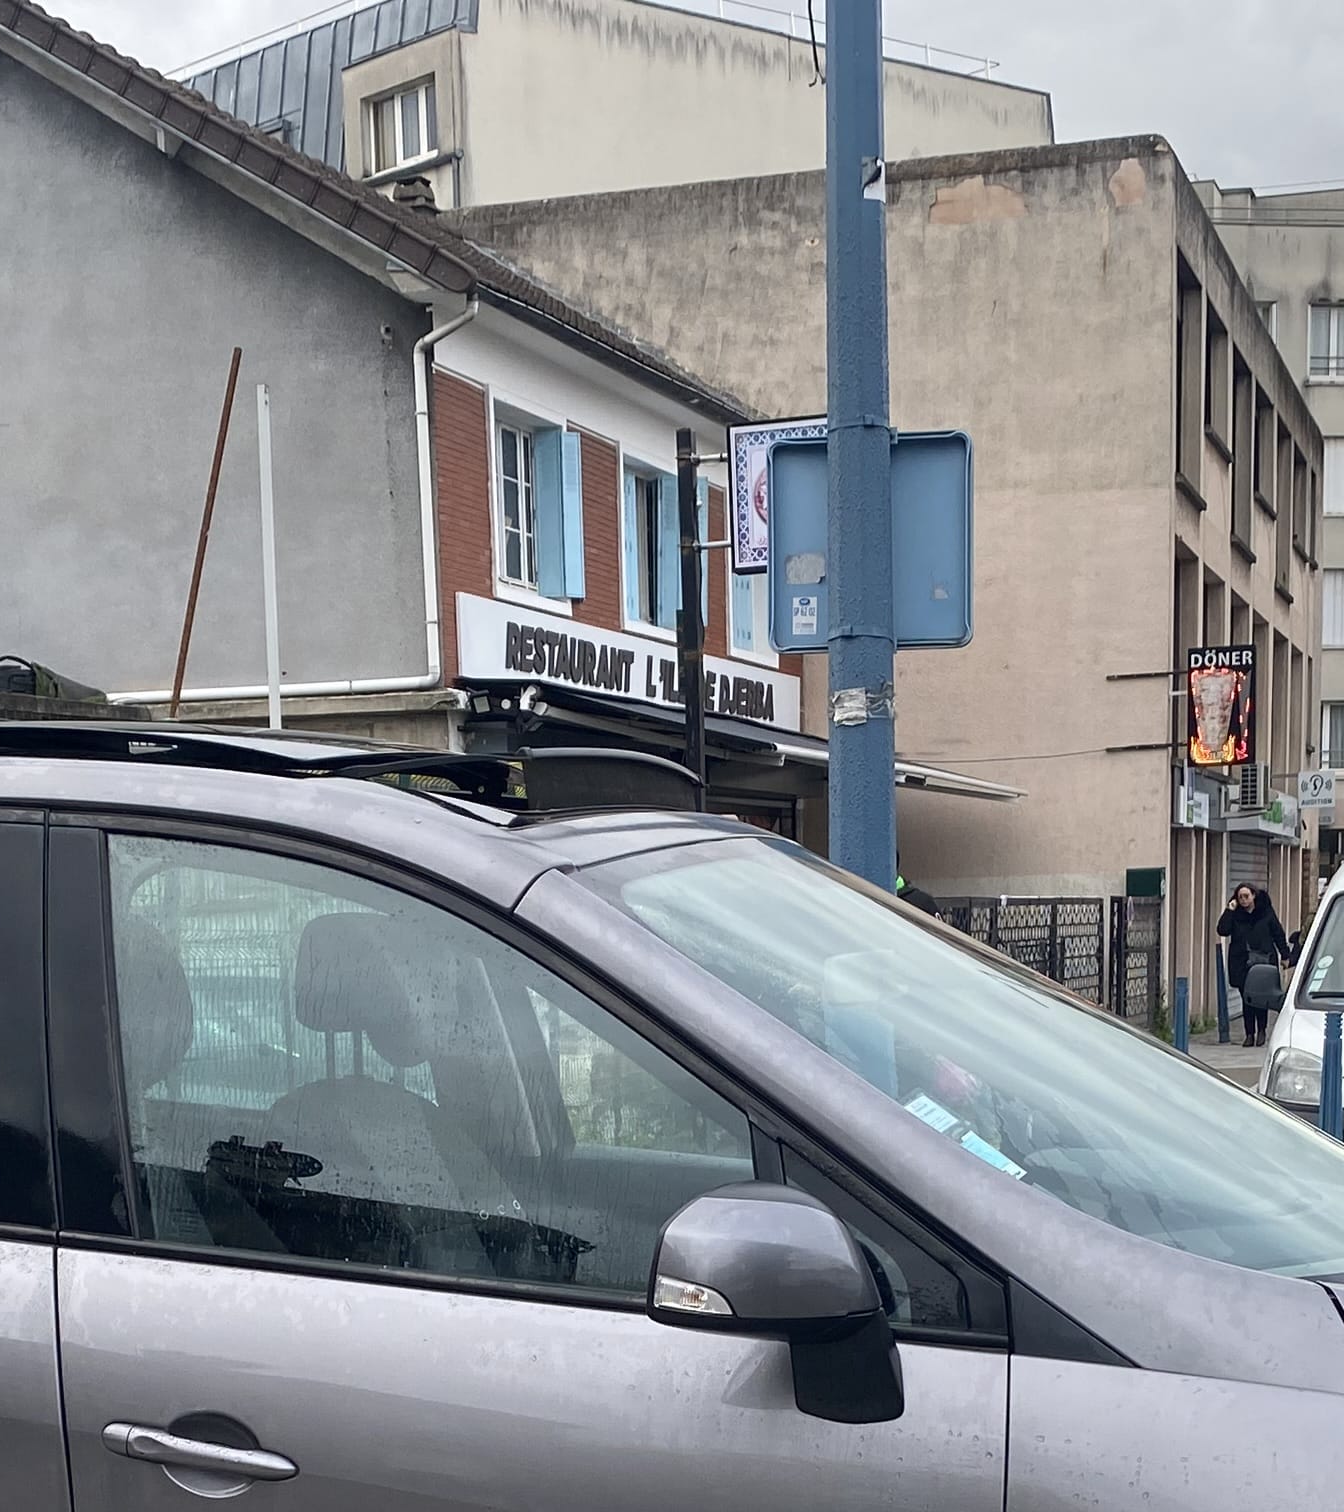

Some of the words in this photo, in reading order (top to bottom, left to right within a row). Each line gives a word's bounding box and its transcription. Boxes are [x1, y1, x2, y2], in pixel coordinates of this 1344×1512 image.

[506, 621, 634, 693] RESTAURANT
[718, 674, 775, 721] DJERBA
[1190, 650, 1253, 668] DÖNER
